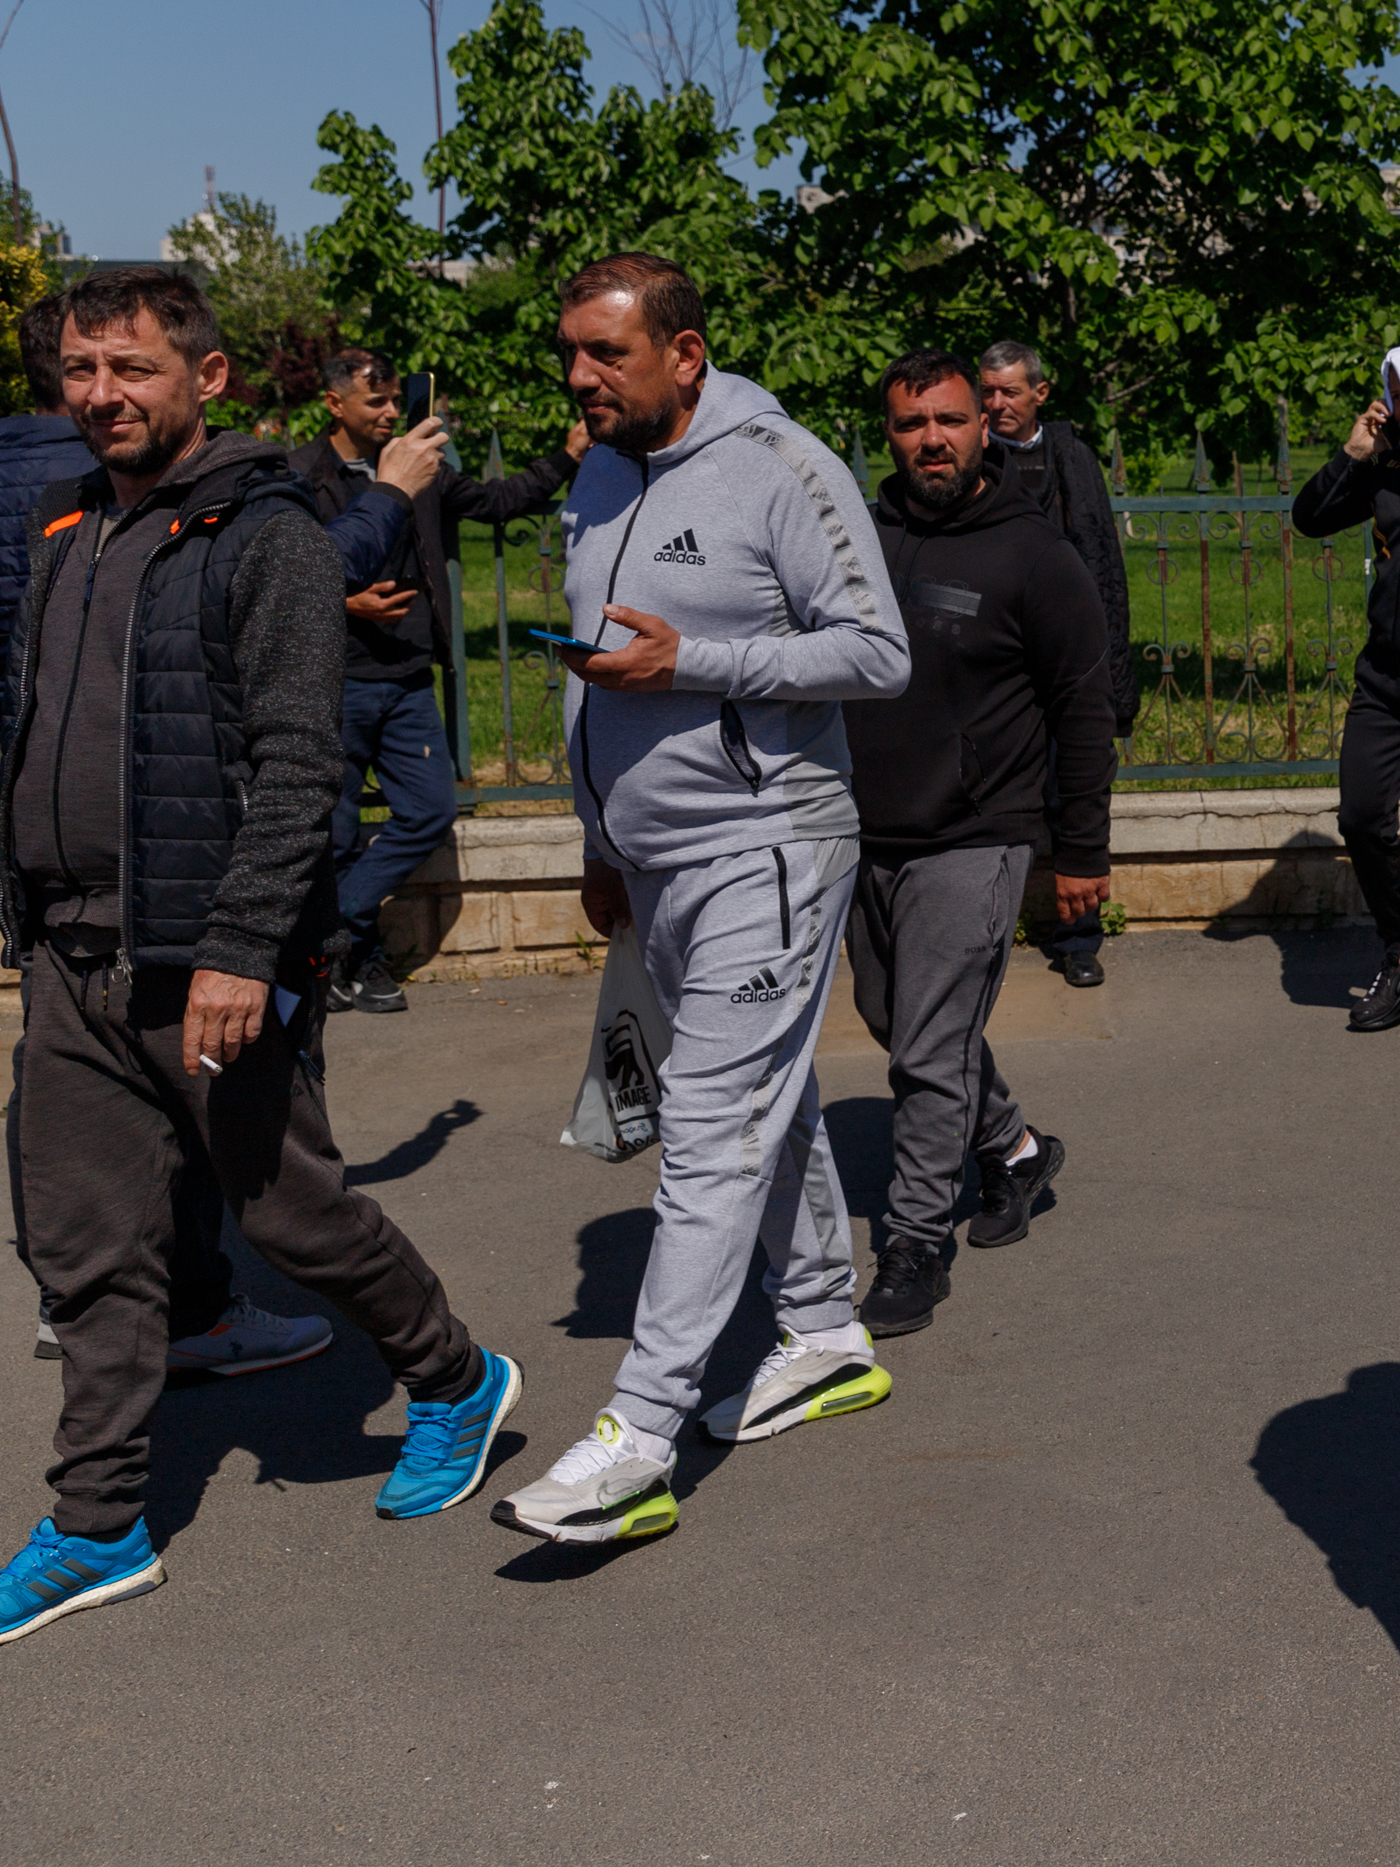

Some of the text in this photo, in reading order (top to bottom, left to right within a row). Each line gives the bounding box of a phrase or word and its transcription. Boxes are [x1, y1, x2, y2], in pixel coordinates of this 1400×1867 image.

[653, 549, 707, 566] adidas
[730, 988, 787, 1004] adidas
[615, 1086, 653, 1112] IMAGE
